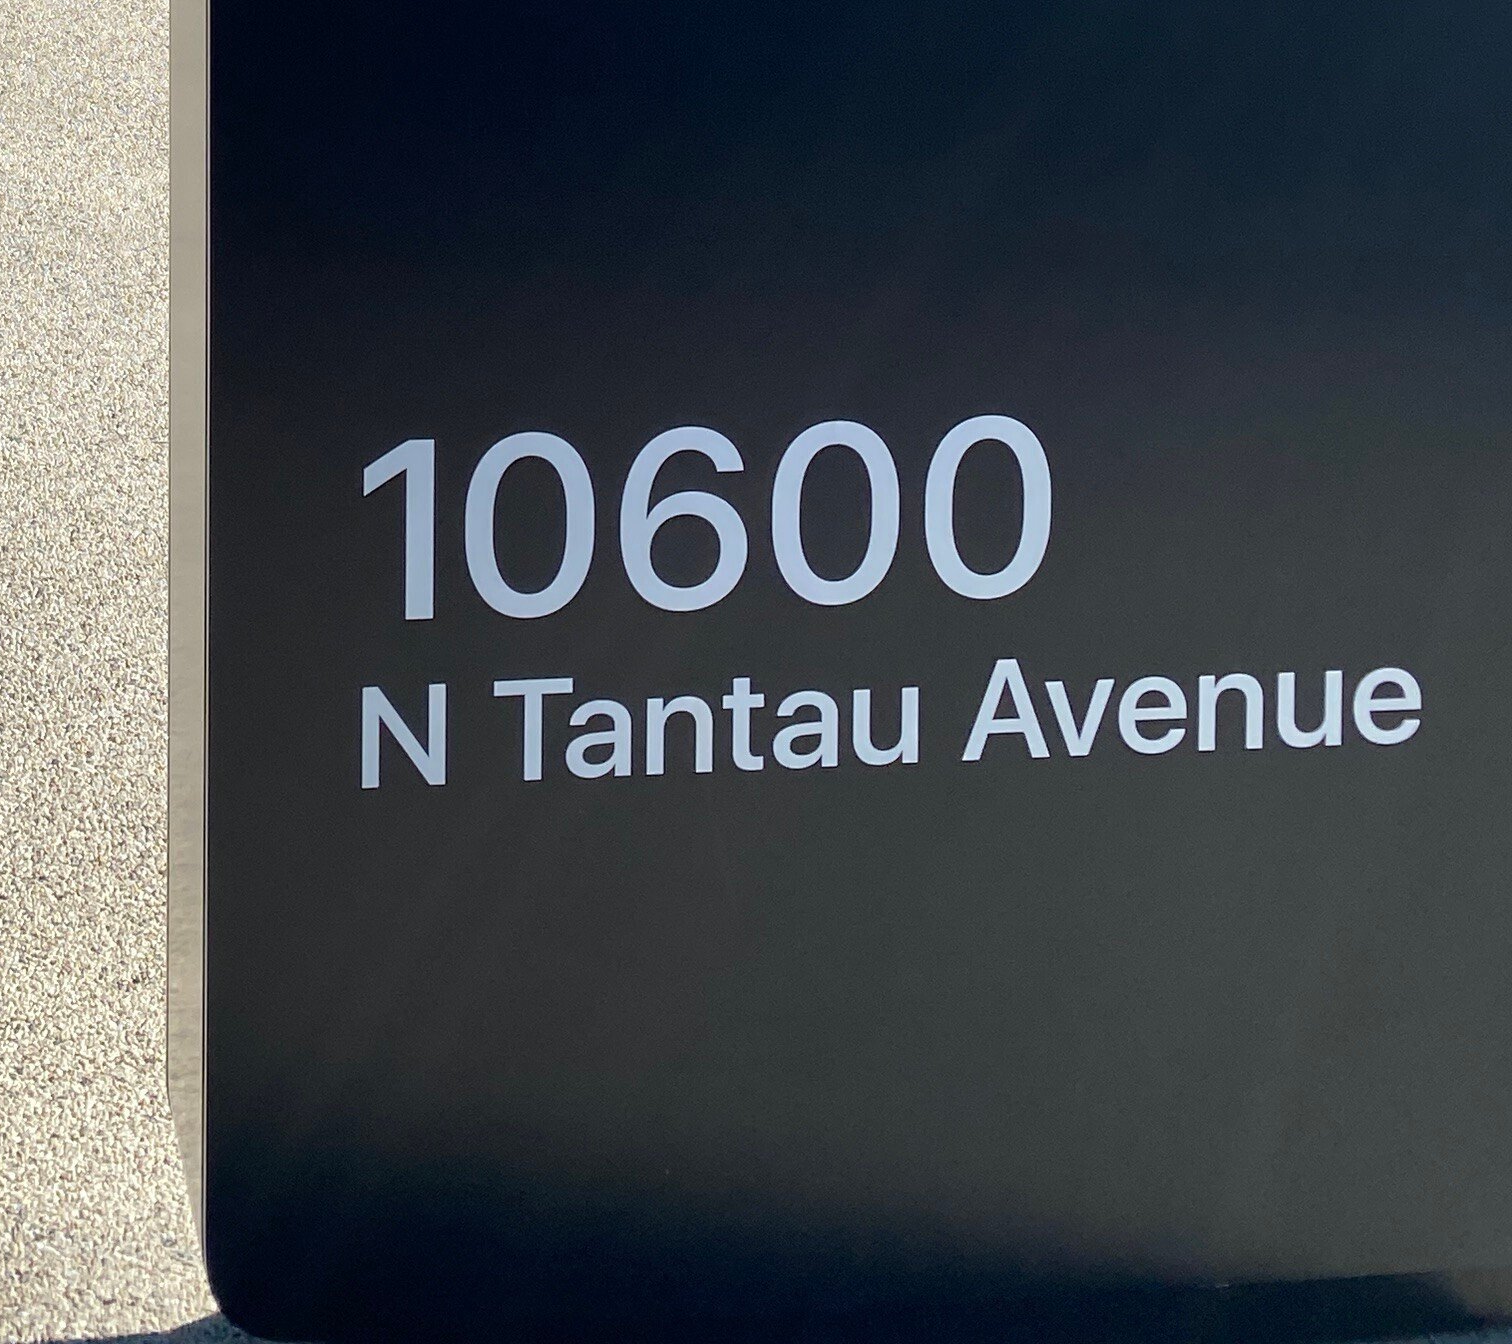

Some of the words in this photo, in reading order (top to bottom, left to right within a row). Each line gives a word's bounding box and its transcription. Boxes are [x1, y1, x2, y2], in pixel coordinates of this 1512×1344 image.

[363, 414, 1052, 621] 10600
[361, 683, 447, 789] N
[493, 677, 920, 782] Tantau
[961, 658, 1422, 762] Avenue
